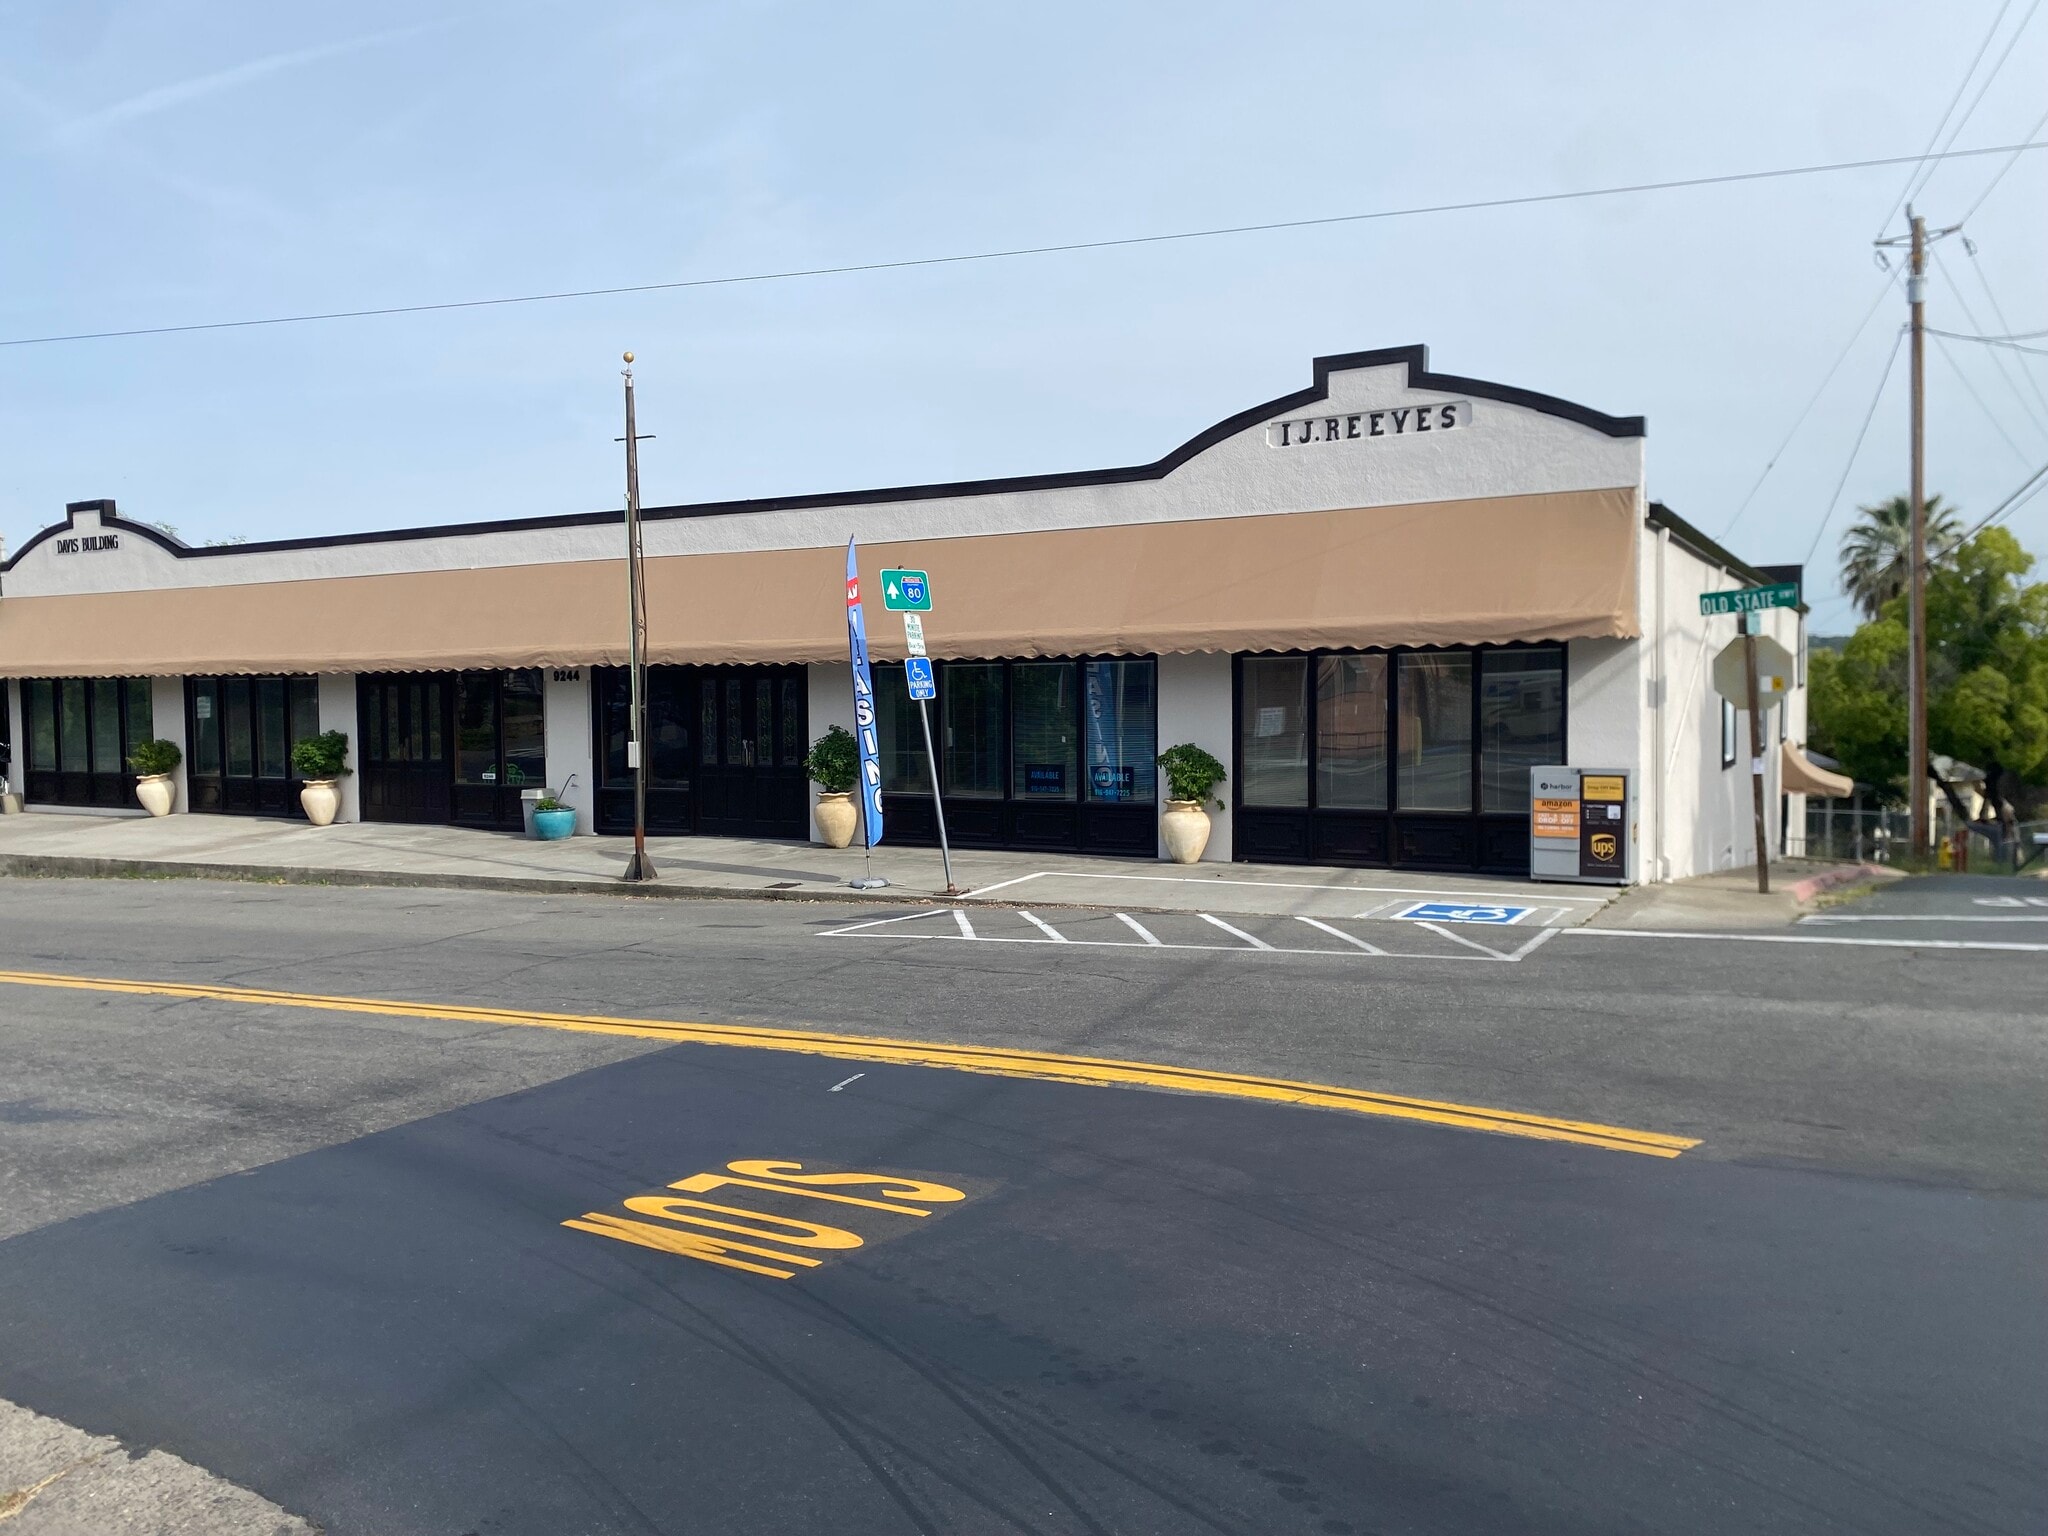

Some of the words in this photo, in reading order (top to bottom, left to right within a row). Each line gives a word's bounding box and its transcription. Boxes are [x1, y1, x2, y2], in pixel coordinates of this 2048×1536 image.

[57, 538, 79, 554] DAVIS
[82, 535, 118, 551] BUILDING
[908, 588, 921, 598] 80
[1701, 596, 1729, 615] OLD
[1734, 591, 1775, 612] STATE
[553, 670, 580, 682] 9244
[910, 680, 933, 690] PARKING
[915, 689, 929, 698] ONLY
[1030, 771, 1060, 780] AVAILABLE
[1094, 773, 1130, 782] AVAILABLE
[1594, 842, 1613, 856] ups
[560, 1159, 967, 1280] SLOW
